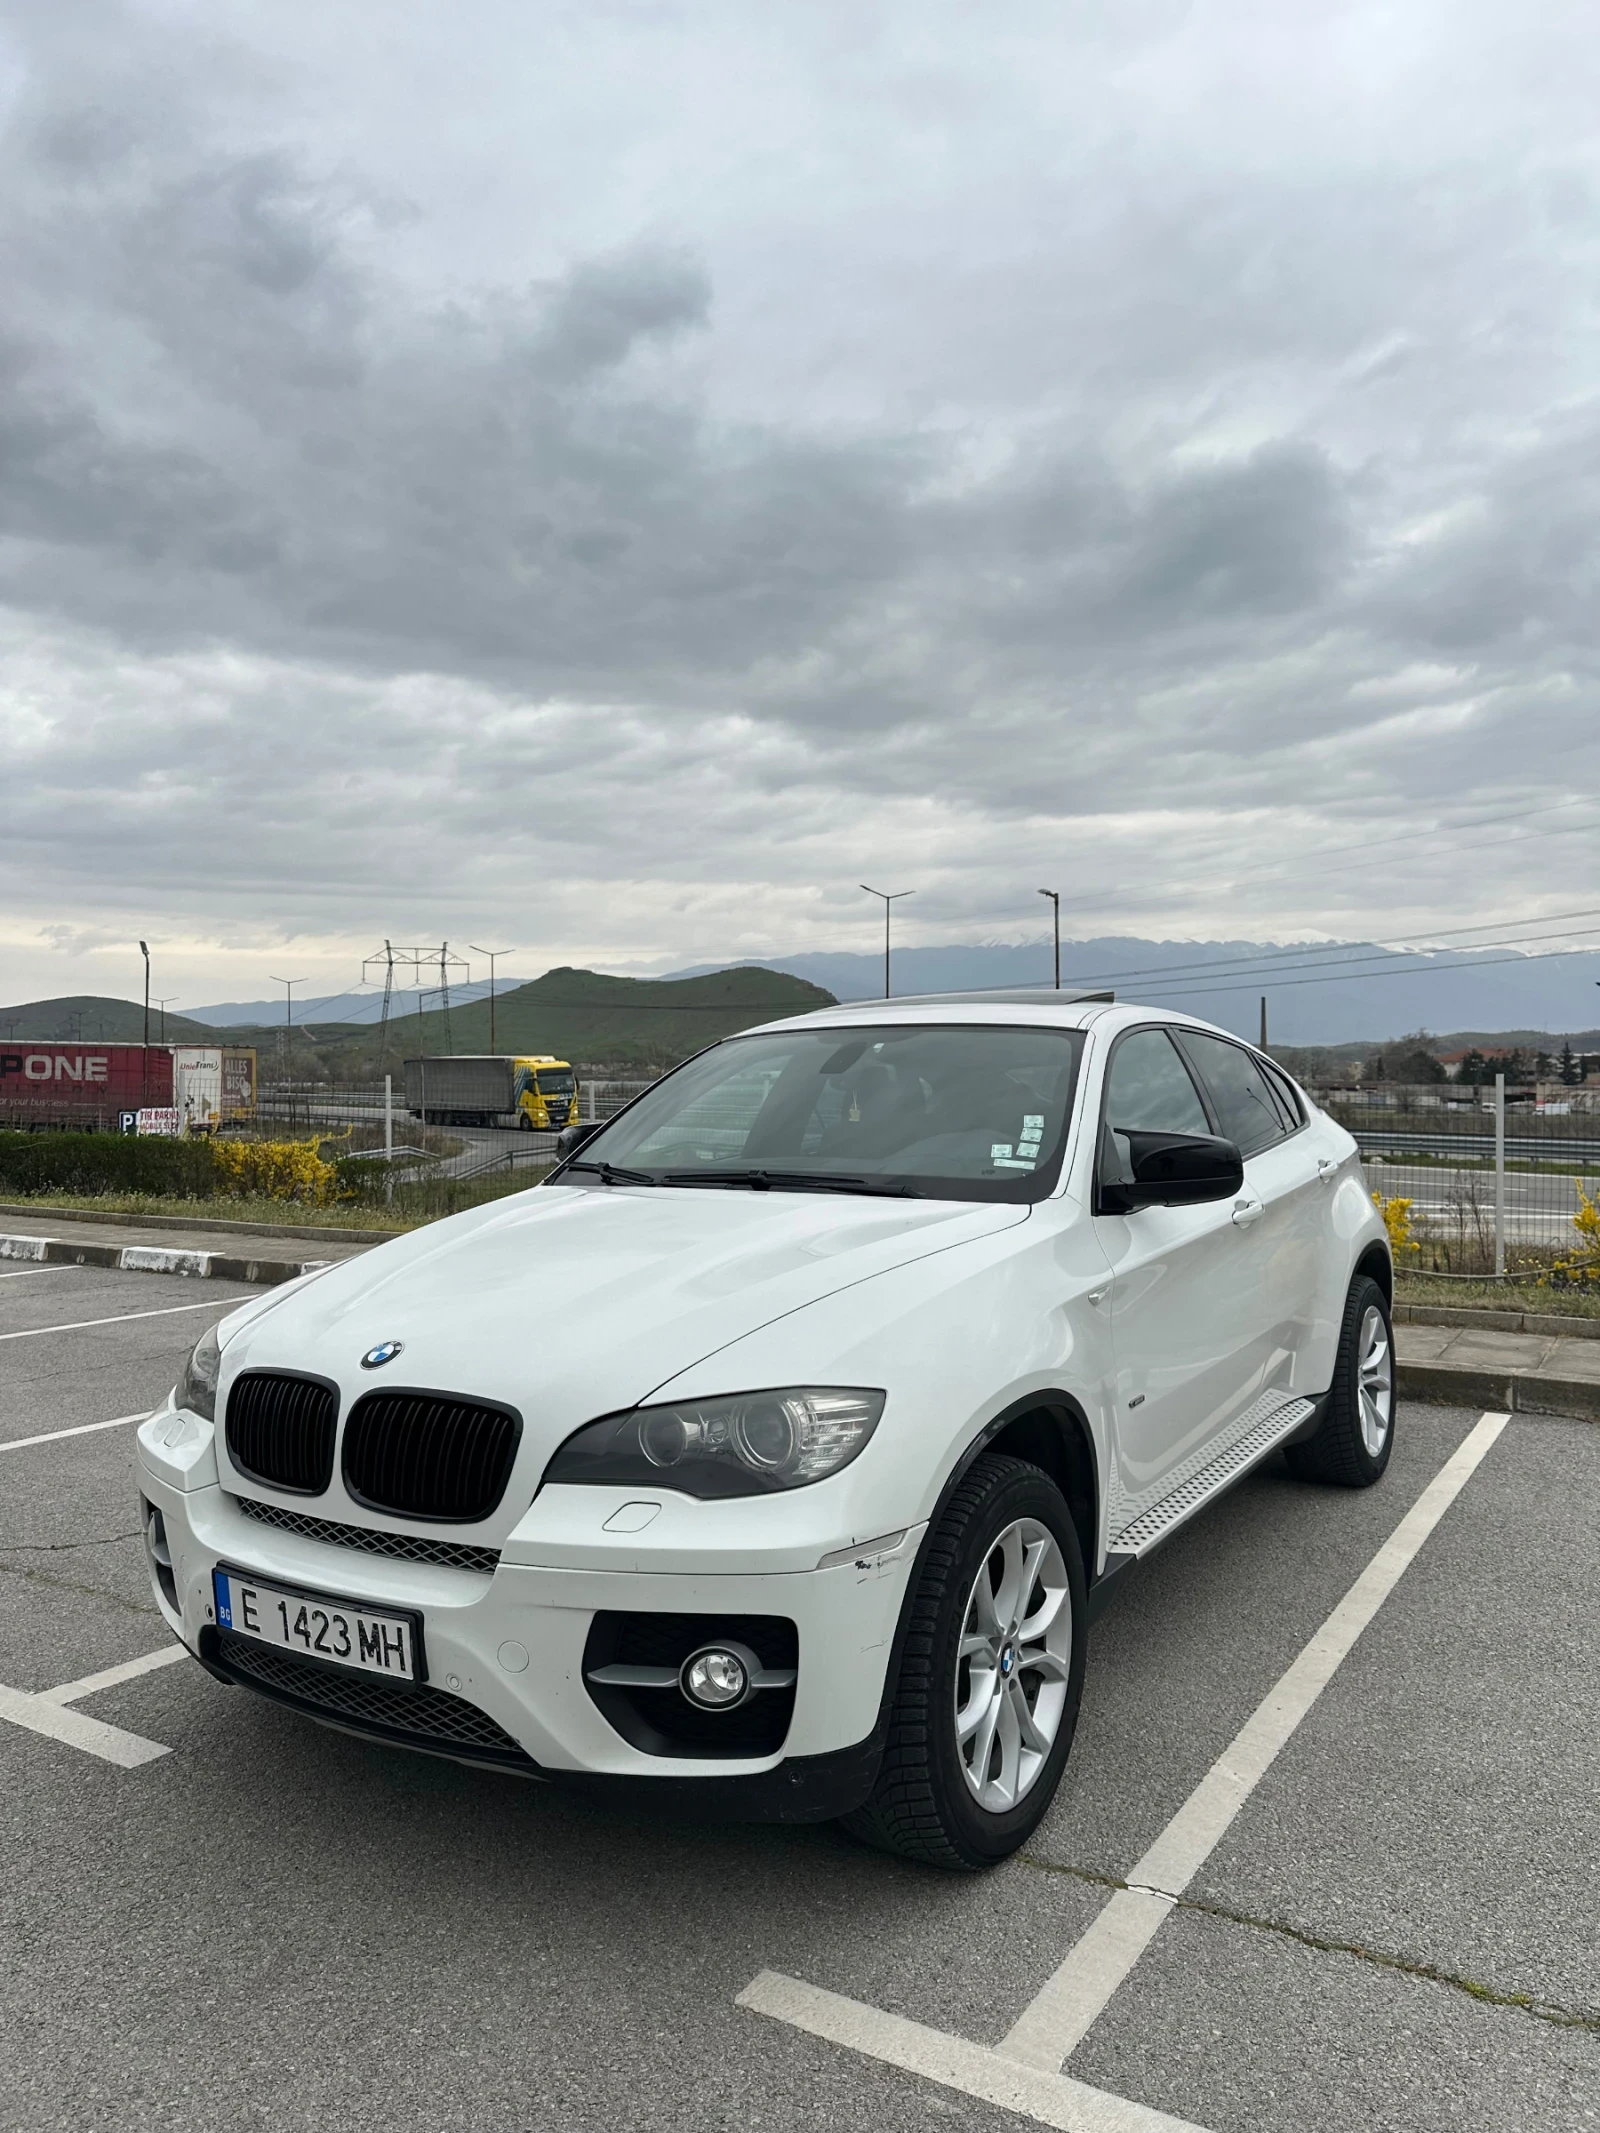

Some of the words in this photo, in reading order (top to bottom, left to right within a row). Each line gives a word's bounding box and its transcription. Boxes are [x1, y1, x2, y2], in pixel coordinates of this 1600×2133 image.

[0, 1054, 108, 1081] PONE
[224, 1059, 248, 1074] ALLES
[9, 1098, 28, 1107] your
[30, 1097, 69, 1107] business
[123, 1114, 134, 1131] P
[220, 1606, 231, 1621] BG
[241, 1588, 261, 1633] E
[277, 1600, 351, 1657] 1423
[357, 1619, 406, 1672] MH
